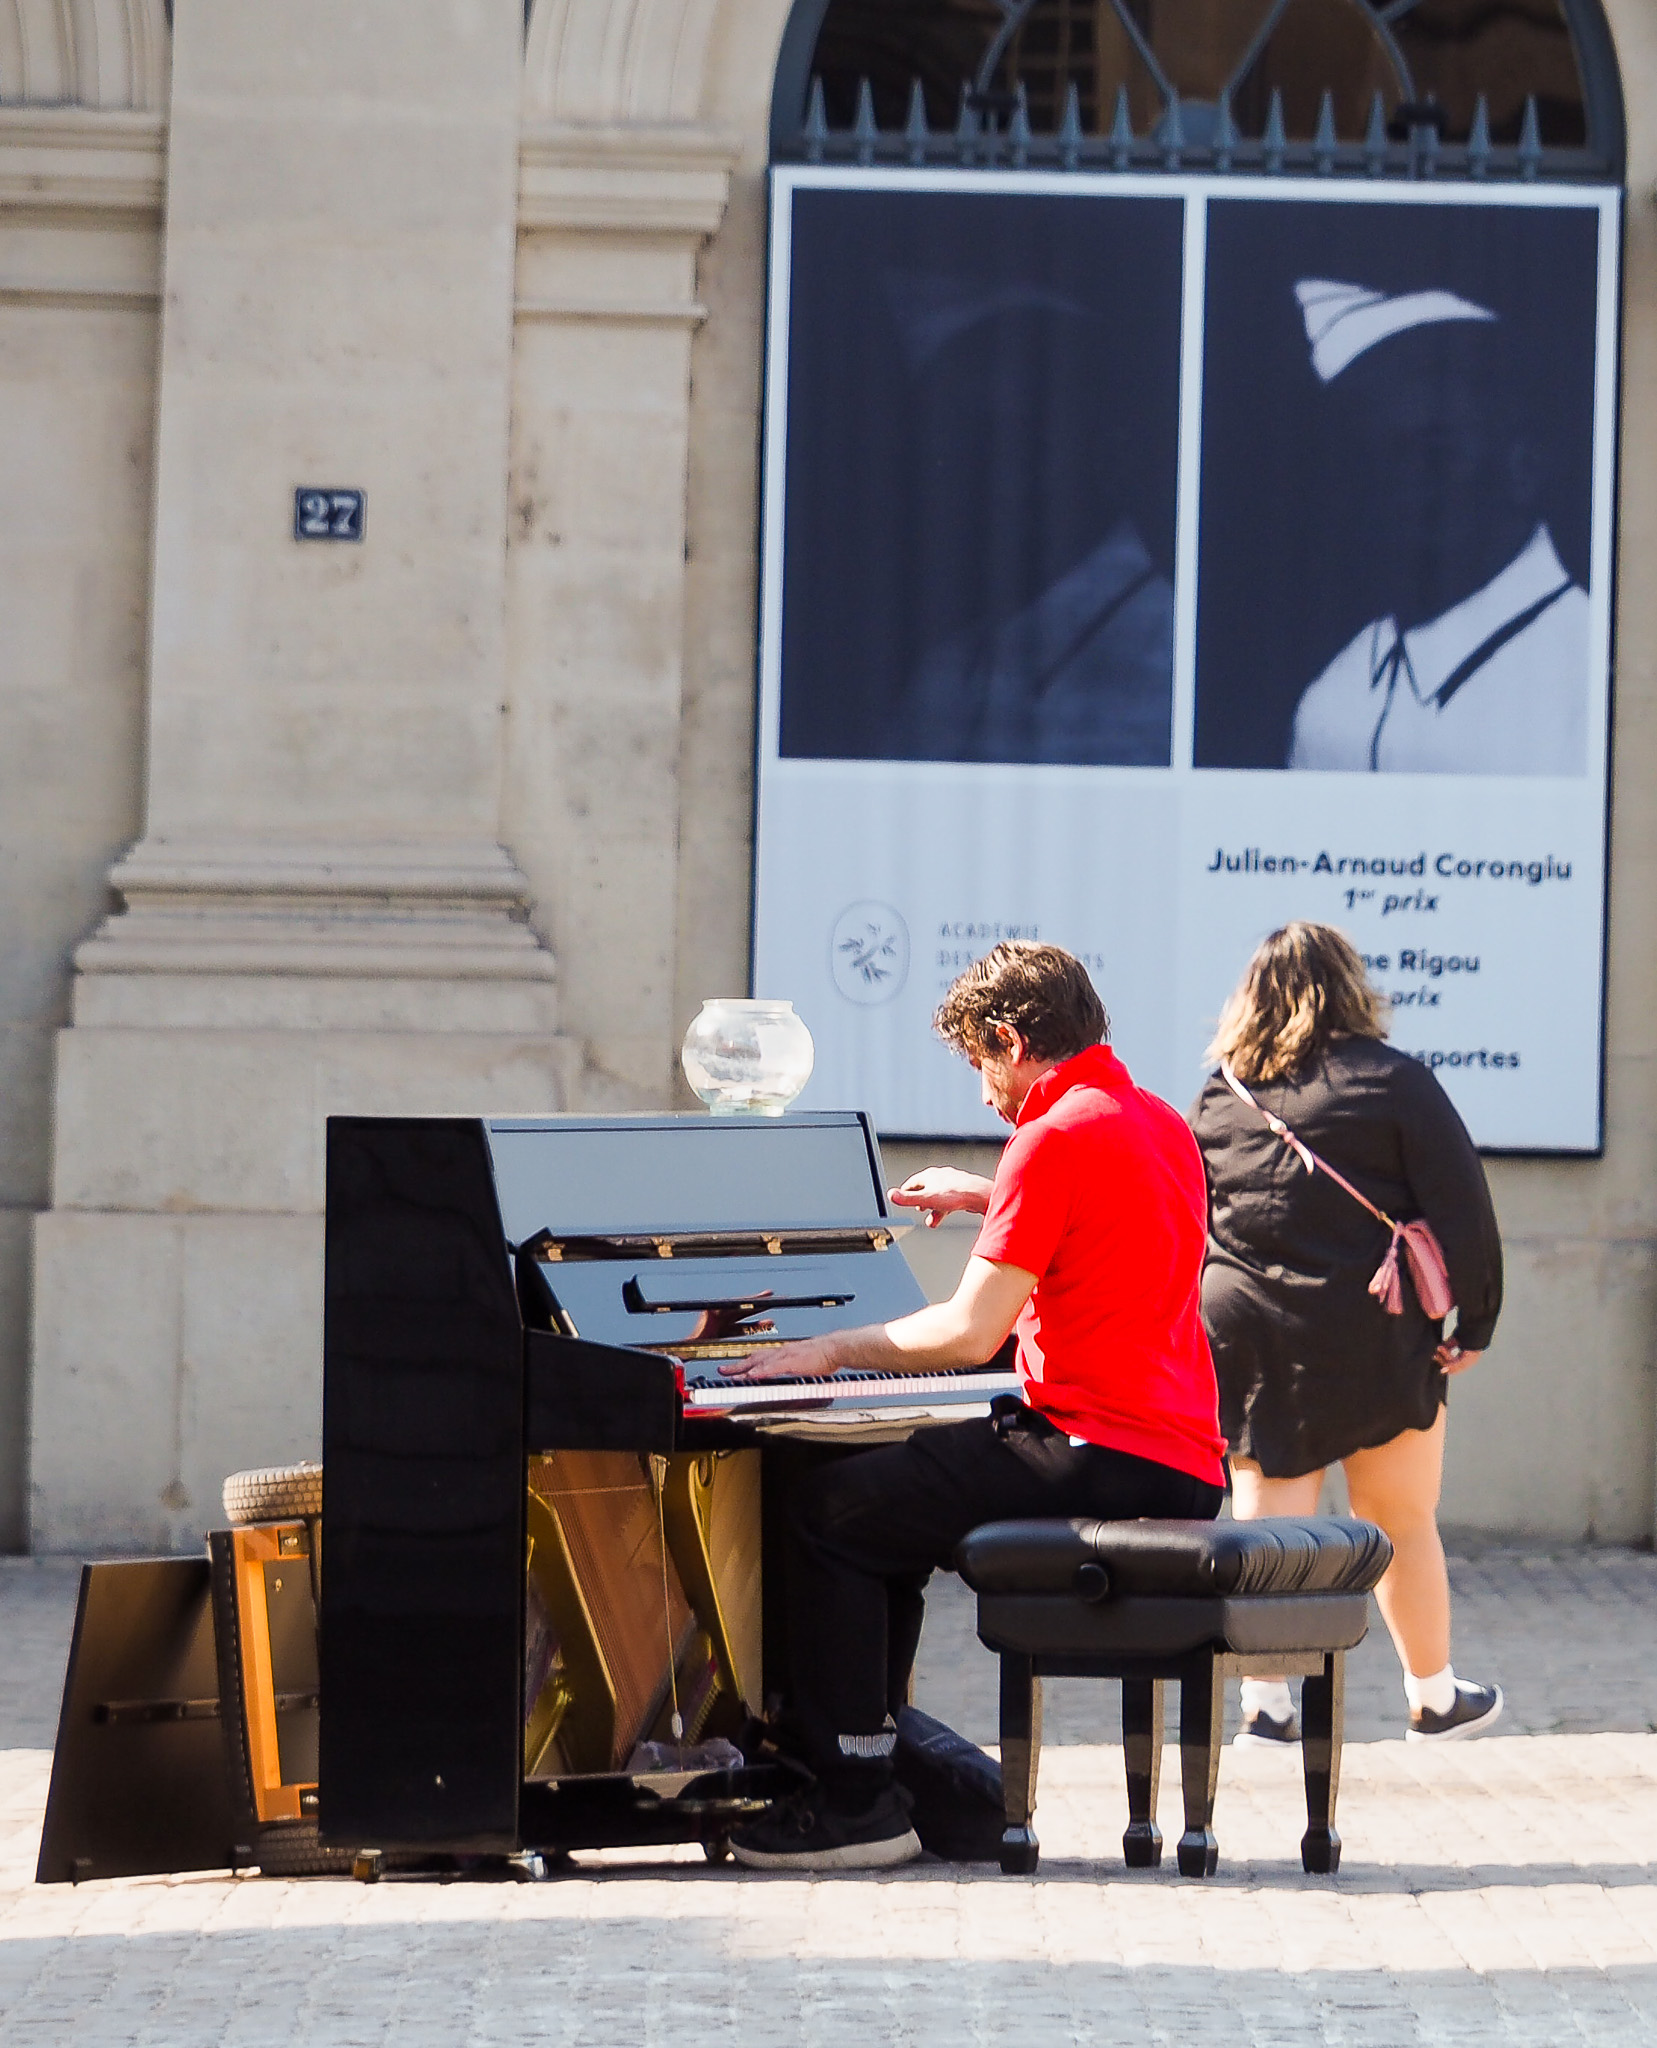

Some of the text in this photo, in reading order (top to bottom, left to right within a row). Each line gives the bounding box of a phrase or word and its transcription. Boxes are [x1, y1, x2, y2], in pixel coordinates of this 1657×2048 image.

[301, 495, 358, 533] 27
[1208, 847, 1572, 885] Julien-Arnaud Corongiu
[1381, 888, 1439, 917] prix
[1361, 949, 1480, 978] ne Rigou
